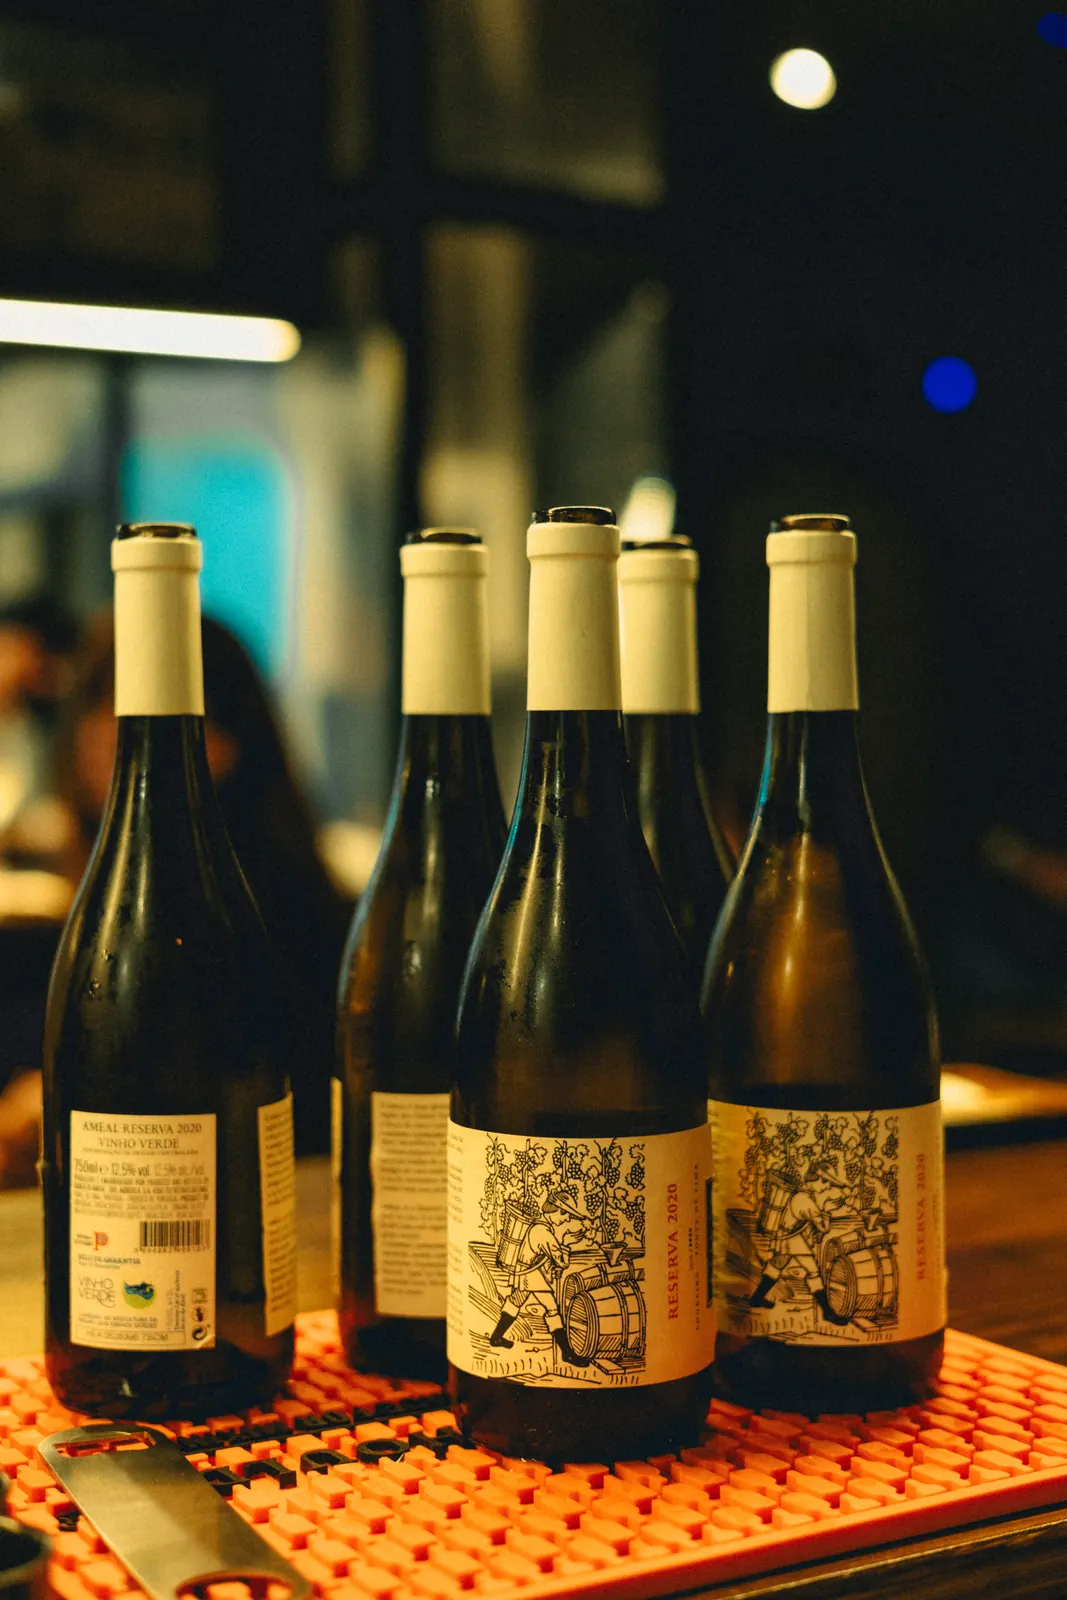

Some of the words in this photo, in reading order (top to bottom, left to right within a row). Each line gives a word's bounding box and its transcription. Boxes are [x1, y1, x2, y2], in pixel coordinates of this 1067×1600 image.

[82, 1121, 118, 1133] AMEAL
[123, 1123, 173, 1134] RESERVA
[177, 1123, 202, 1134] 2020
[97, 1137, 137, 1149] VINHO
[140, 1138, 180, 1149] VERDE
[916, 1153, 926, 1190] 2020
[667, 1183, 678, 1222] 2020
[916, 1197, 926, 1280] RESERVA
[78, 1276, 114, 1290] VINHO
[667, 1230, 679, 1319] RESERVA
[78, 1287, 116, 1308] VERDE
